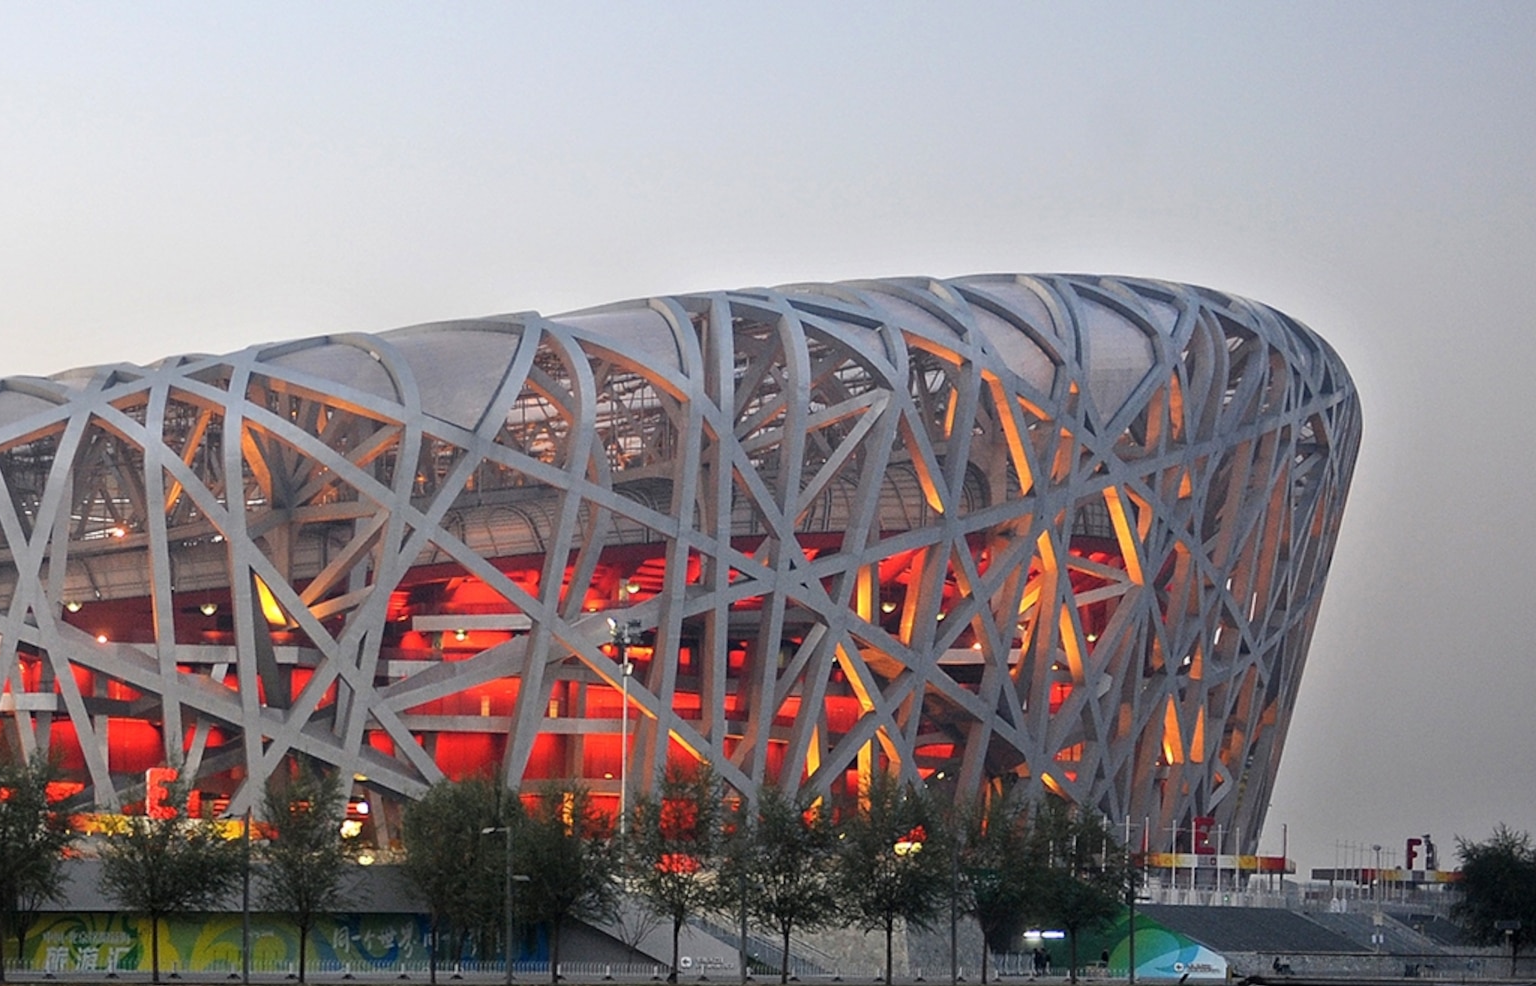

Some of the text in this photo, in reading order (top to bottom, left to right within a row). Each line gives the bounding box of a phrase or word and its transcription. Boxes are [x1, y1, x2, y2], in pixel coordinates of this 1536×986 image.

[146, 767, 178, 820] E
[1193, 816, 1216, 854] E
[1407, 838, 1422, 870] F
